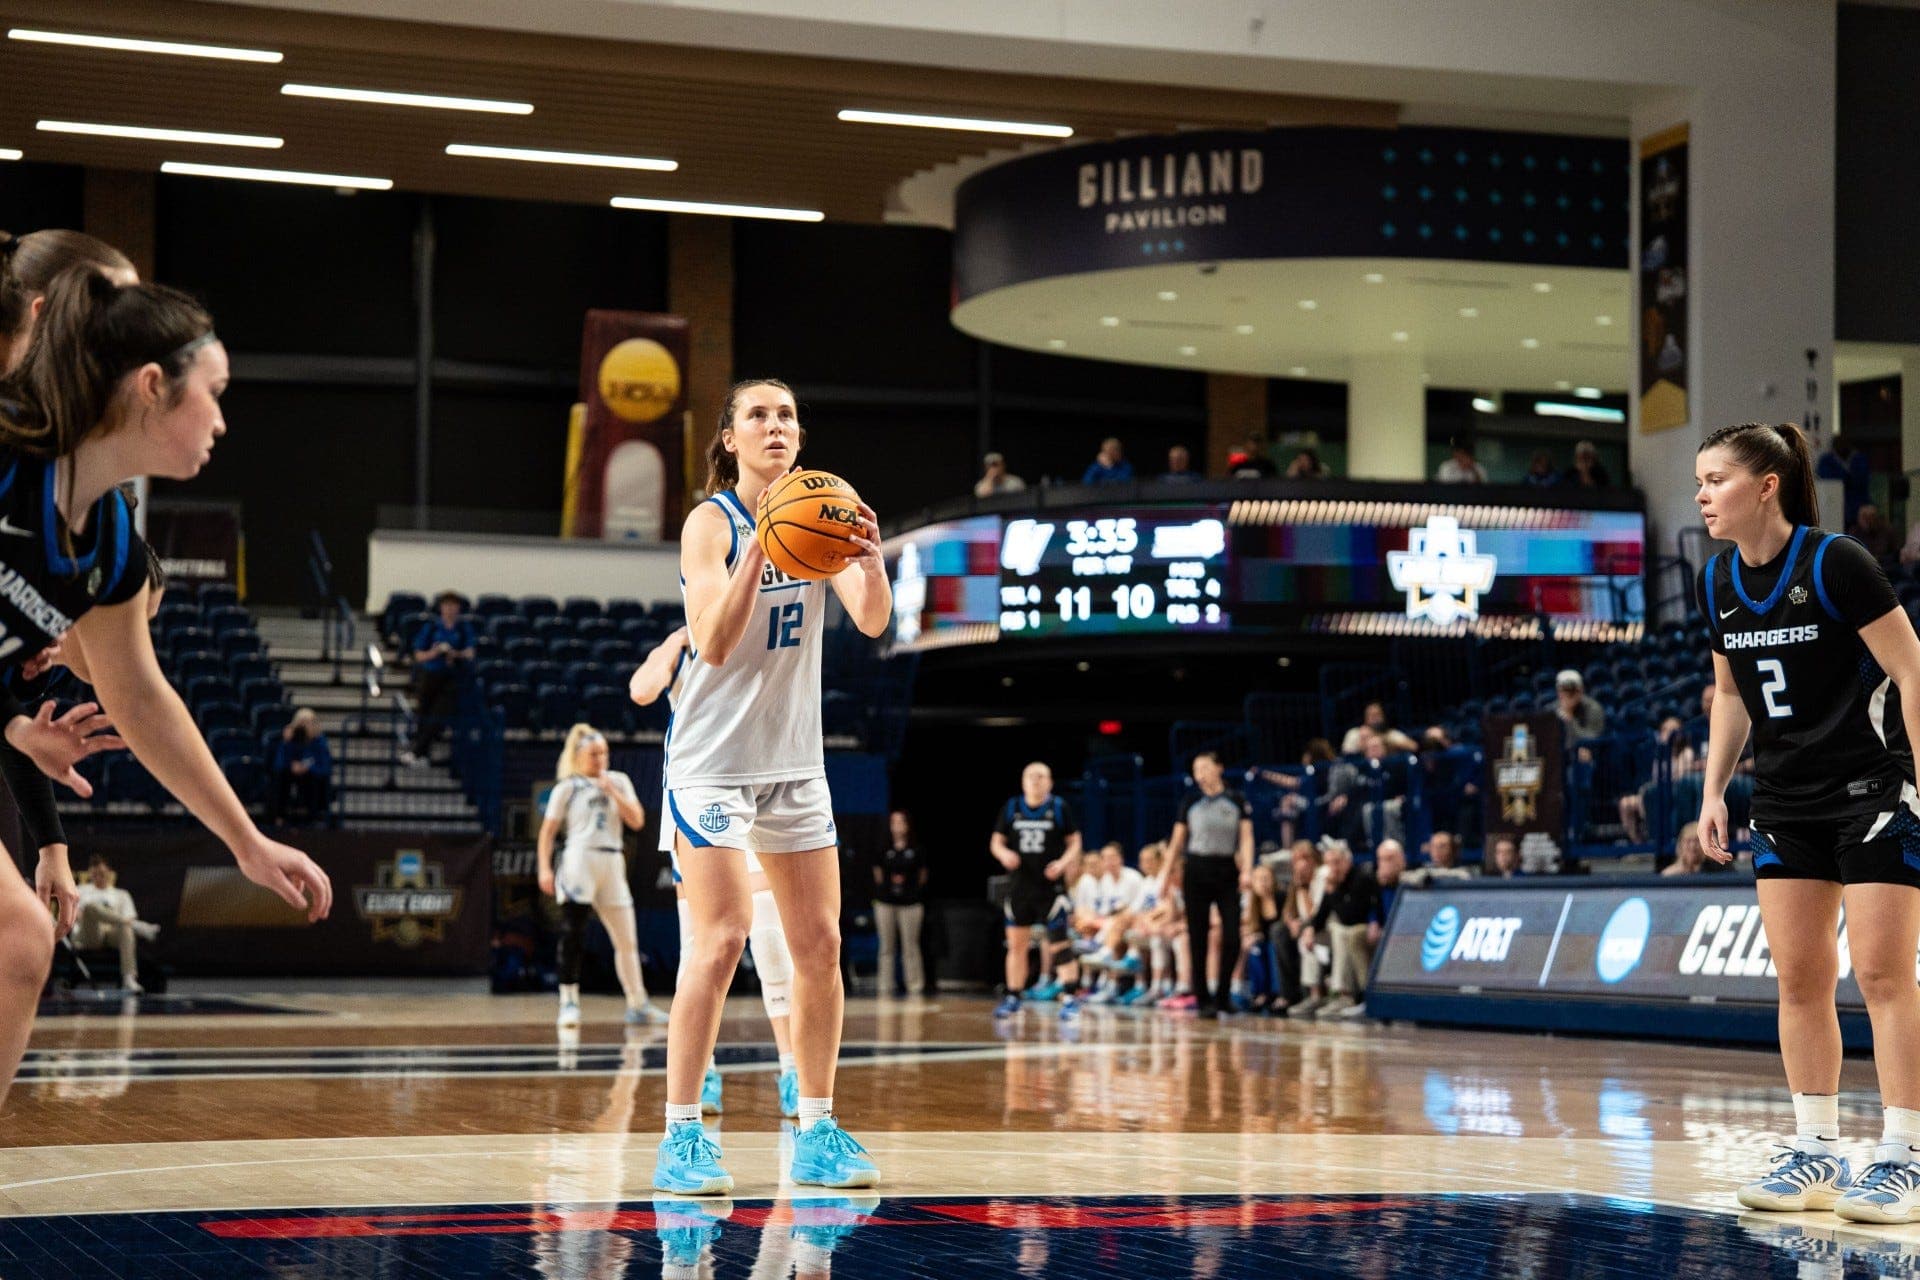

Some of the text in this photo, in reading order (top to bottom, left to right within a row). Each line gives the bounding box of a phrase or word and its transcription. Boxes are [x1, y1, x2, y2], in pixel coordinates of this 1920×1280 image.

[1078, 149, 1263, 208] GILLIAND
[1105, 203, 1227, 234] PAVILION
[1065, 518, 1138, 556] 3:35
[1055, 587, 1091, 622] 11
[1112, 583, 1155, 619] 10
[767, 601, 804, 650] 12
[1723, 624, 1819, 649] CHARGERS
[1756, 658, 1793, 718] 2
[1019, 829, 1046, 853] 22
[1451, 917, 1522, 961] AT&T
